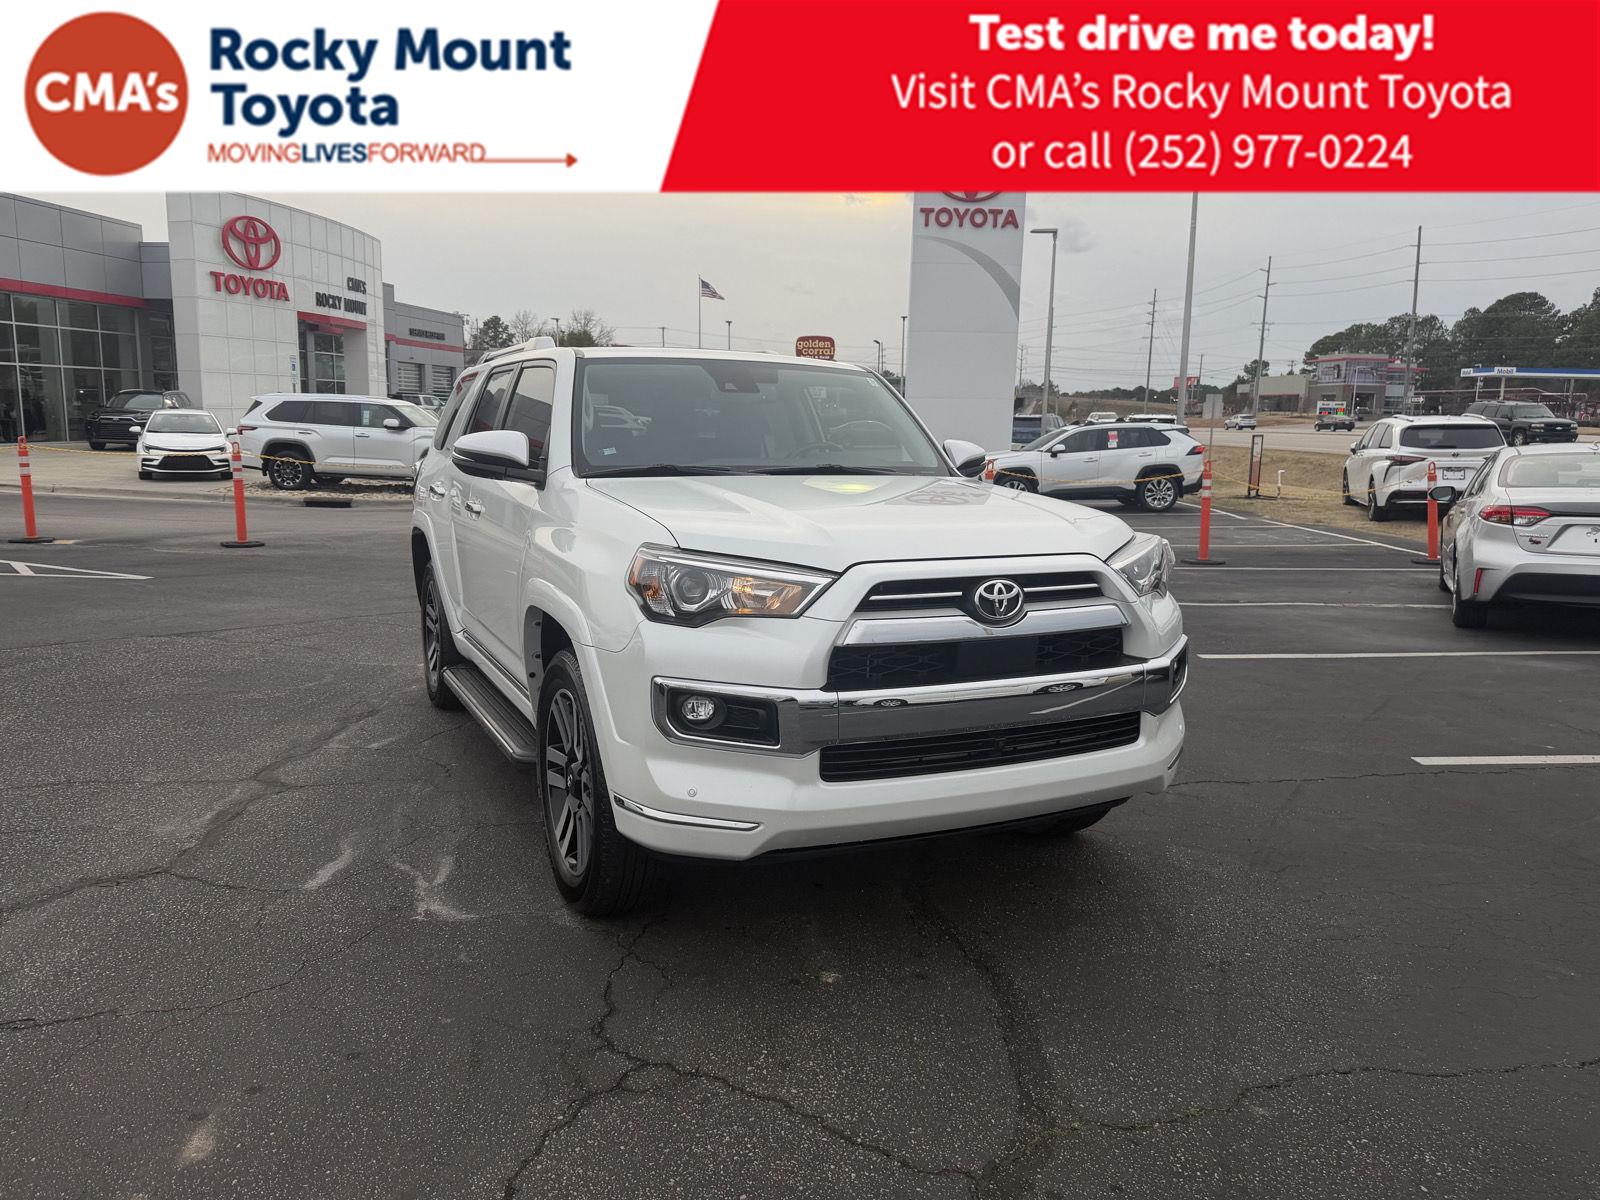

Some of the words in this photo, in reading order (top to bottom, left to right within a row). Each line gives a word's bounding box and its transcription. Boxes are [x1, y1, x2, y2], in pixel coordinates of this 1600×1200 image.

[920, 207, 1019, 229] TOYOTA
[210, 270, 290, 302] TOYOTA
[315, 291, 342, 310] ROCKY
[797, 340, 831, 349] golden
[802, 347, 834, 355] corral
